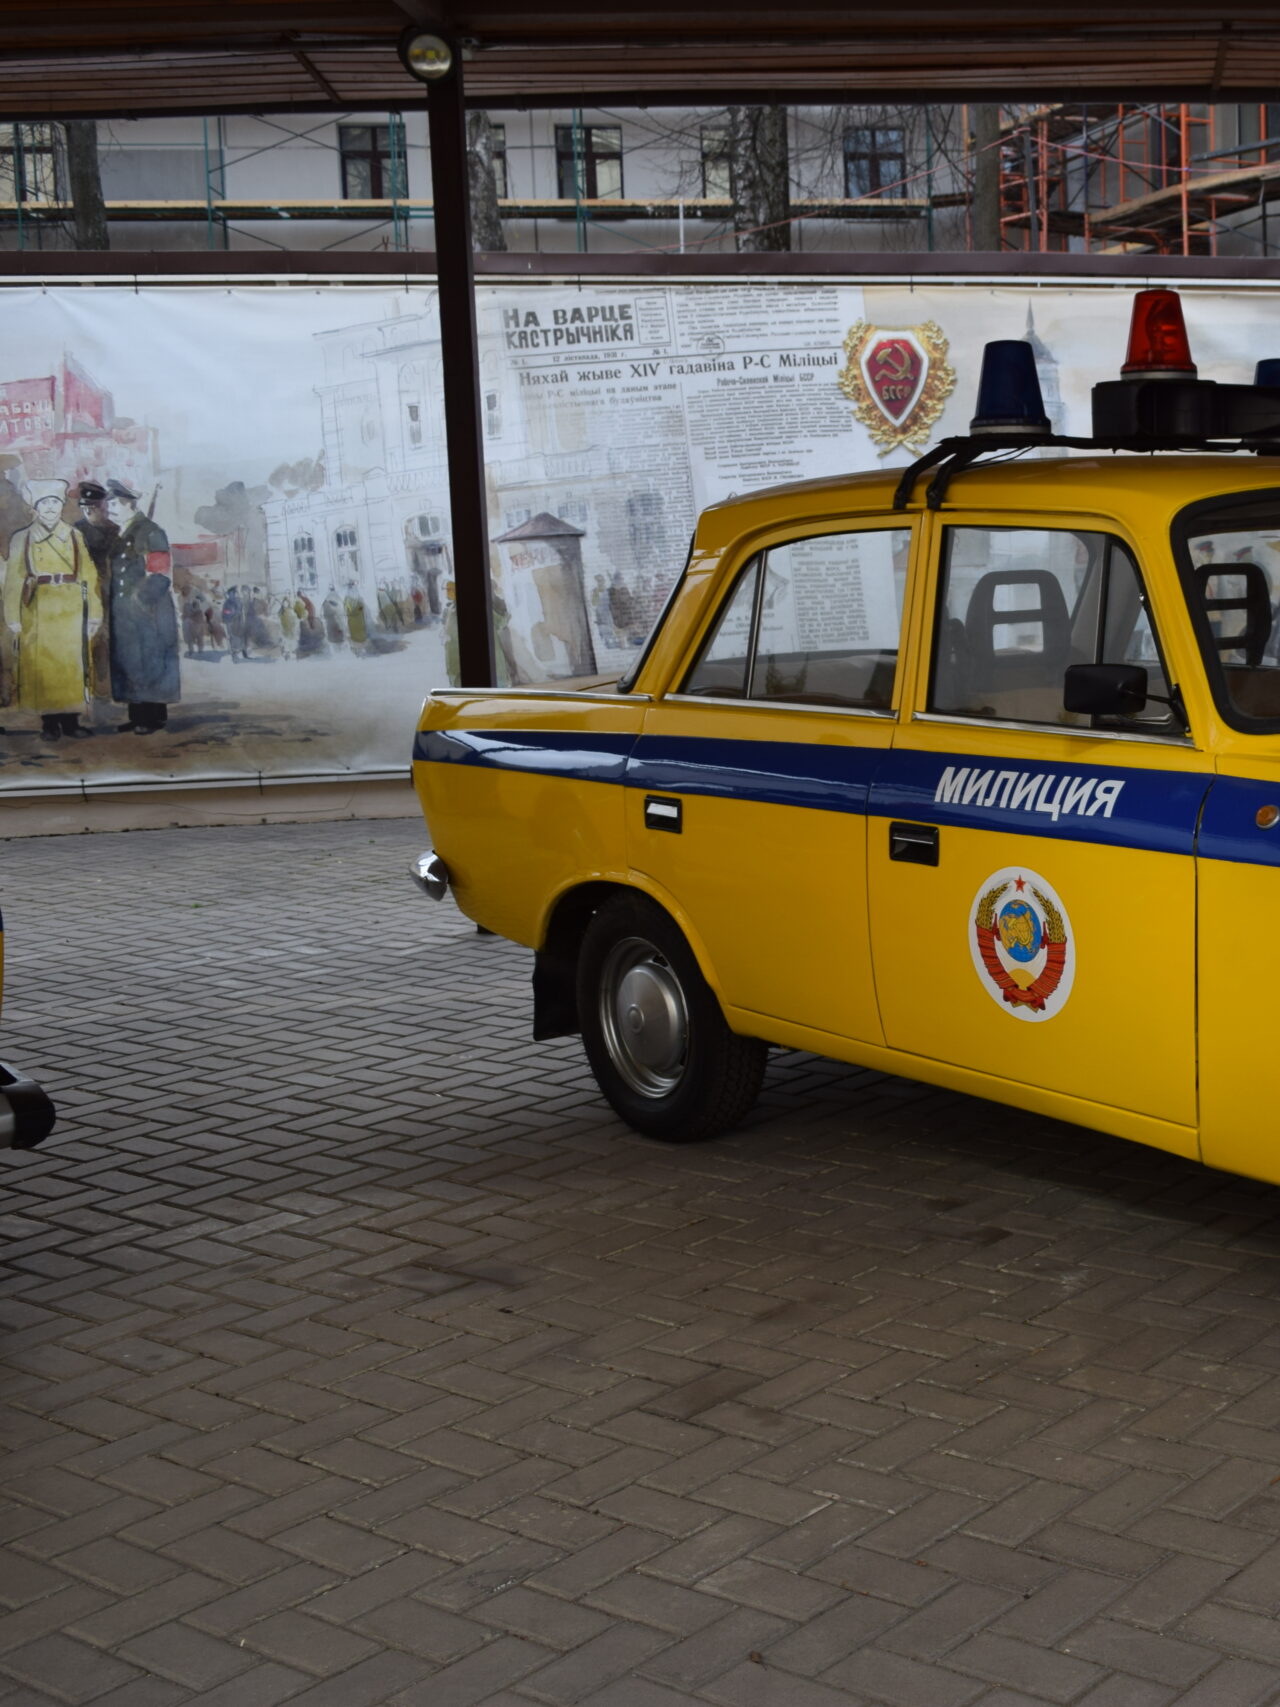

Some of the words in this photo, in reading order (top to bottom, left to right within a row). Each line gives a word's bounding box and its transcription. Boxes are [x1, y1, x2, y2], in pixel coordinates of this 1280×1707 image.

[553, 304, 632, 325] ВАРЦЕ
[505, 323, 634, 349] КАСТРЫЧНІКА
[518, 369, 568, 387] Няхай
[577, 366, 621, 382] жыве
[630, 362, 660, 378] XIV
[669, 358, 735, 376] гадавіна
[742, 354, 772, 370] Р-С
[778, 352, 838, 369] Міліцыі
[934, 766, 1126, 822] МИЛИЦИЯ
